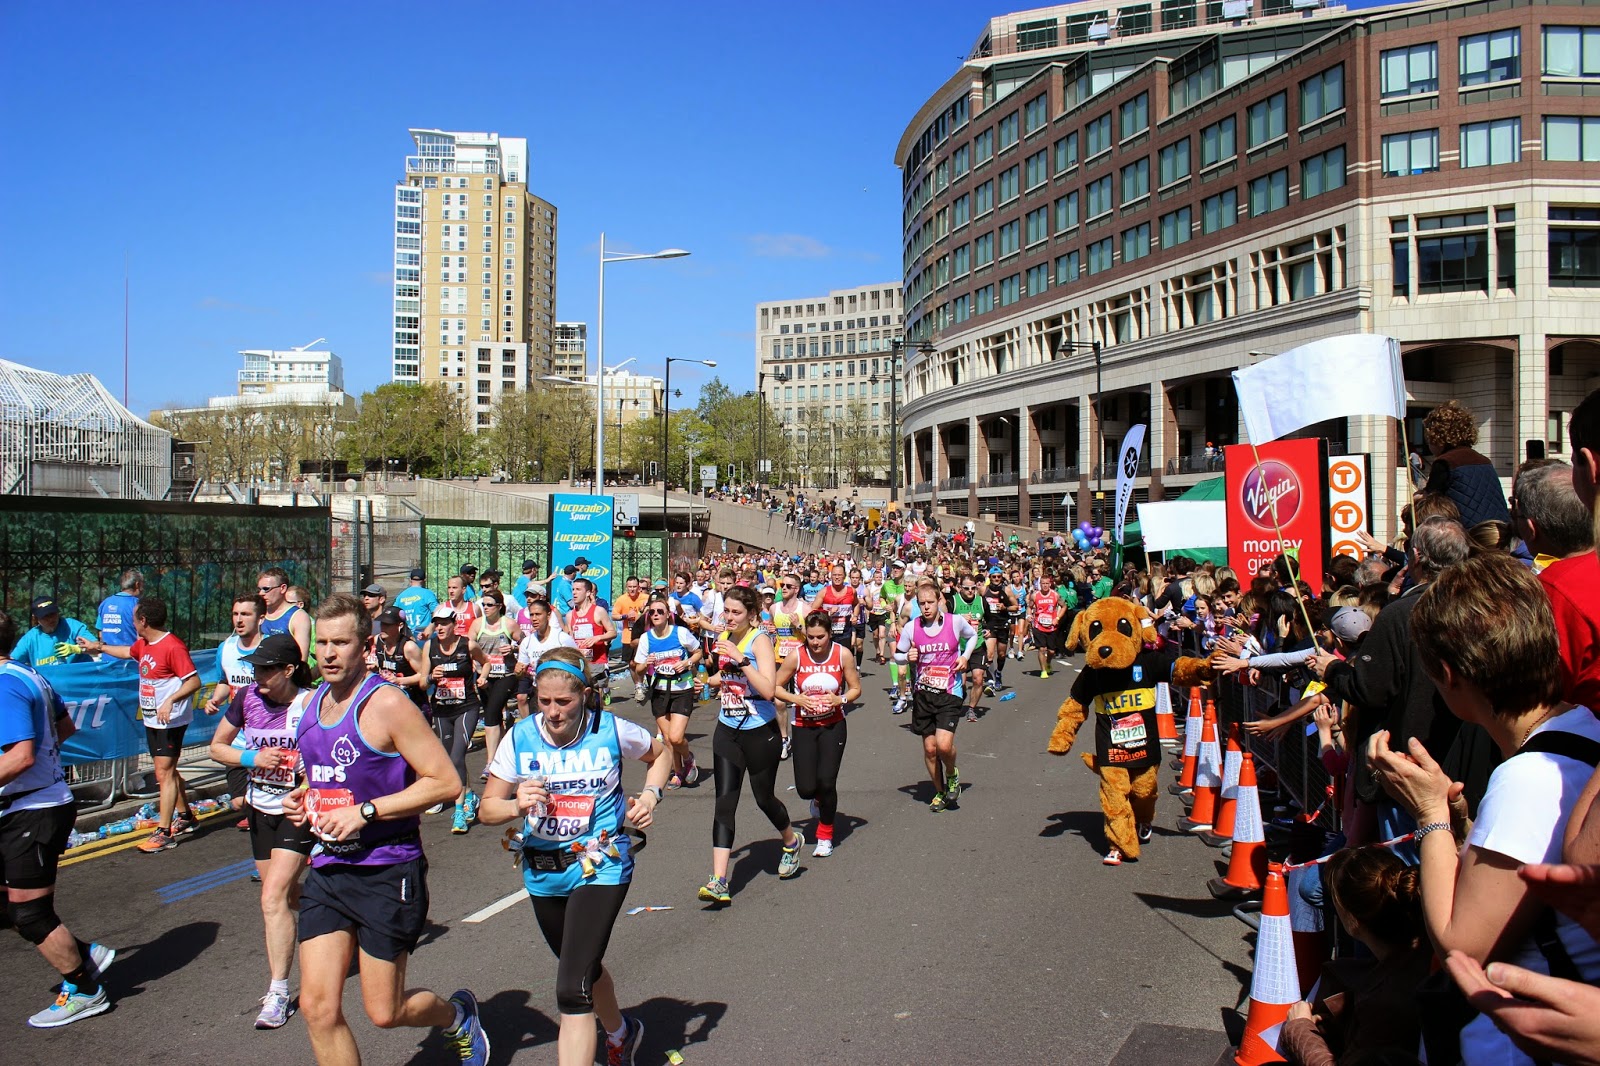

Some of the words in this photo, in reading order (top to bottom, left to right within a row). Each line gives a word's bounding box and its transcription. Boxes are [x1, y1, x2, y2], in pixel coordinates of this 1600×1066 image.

[1247, 470, 1296, 519] Virgin
[555, 501, 602, 513] Lucozade
[569, 512, 591, 521] Sport
[554, 531, 601, 543] Lucozade
[568, 542, 590, 552] Sport
[1243, 539, 1303, 552] money
[919, 642, 950, 653] WOZZA
[800, 665, 840, 673] ANNIKA
[1104, 693, 1142, 710] ALFIE
[252, 736, 297, 749] KAREN
[520, 747, 615, 775] EMMA
[590, 777, 608, 788] UK
[321, 796, 350, 806] money
[557, 800, 592, 811] money
